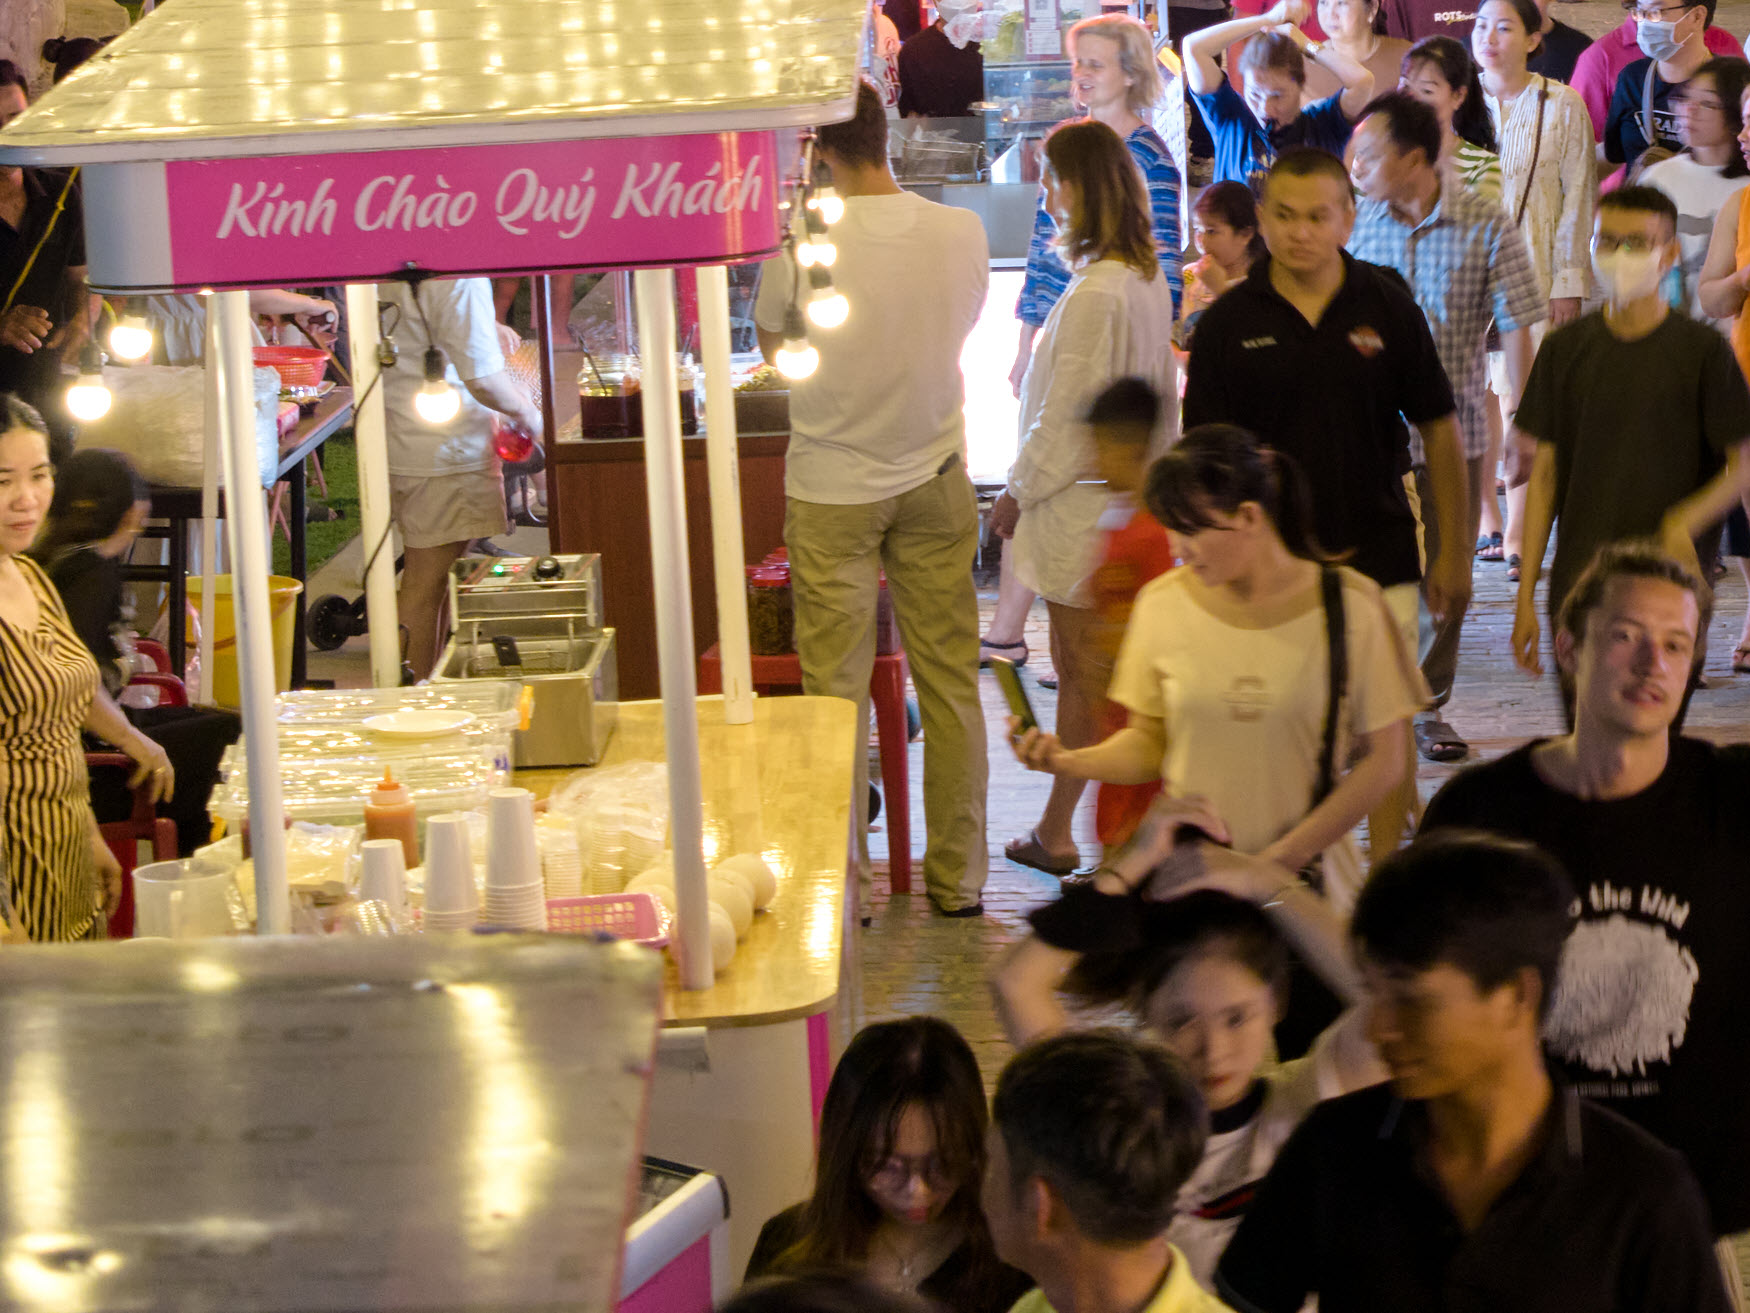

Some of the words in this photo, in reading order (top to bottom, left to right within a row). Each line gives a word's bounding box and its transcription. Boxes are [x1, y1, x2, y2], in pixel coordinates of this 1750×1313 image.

[216, 178, 338, 239] Kính
[354, 174, 477, 232] Chào
[496, 167, 597, 240] Quý
[610, 155, 762, 220] Khách
